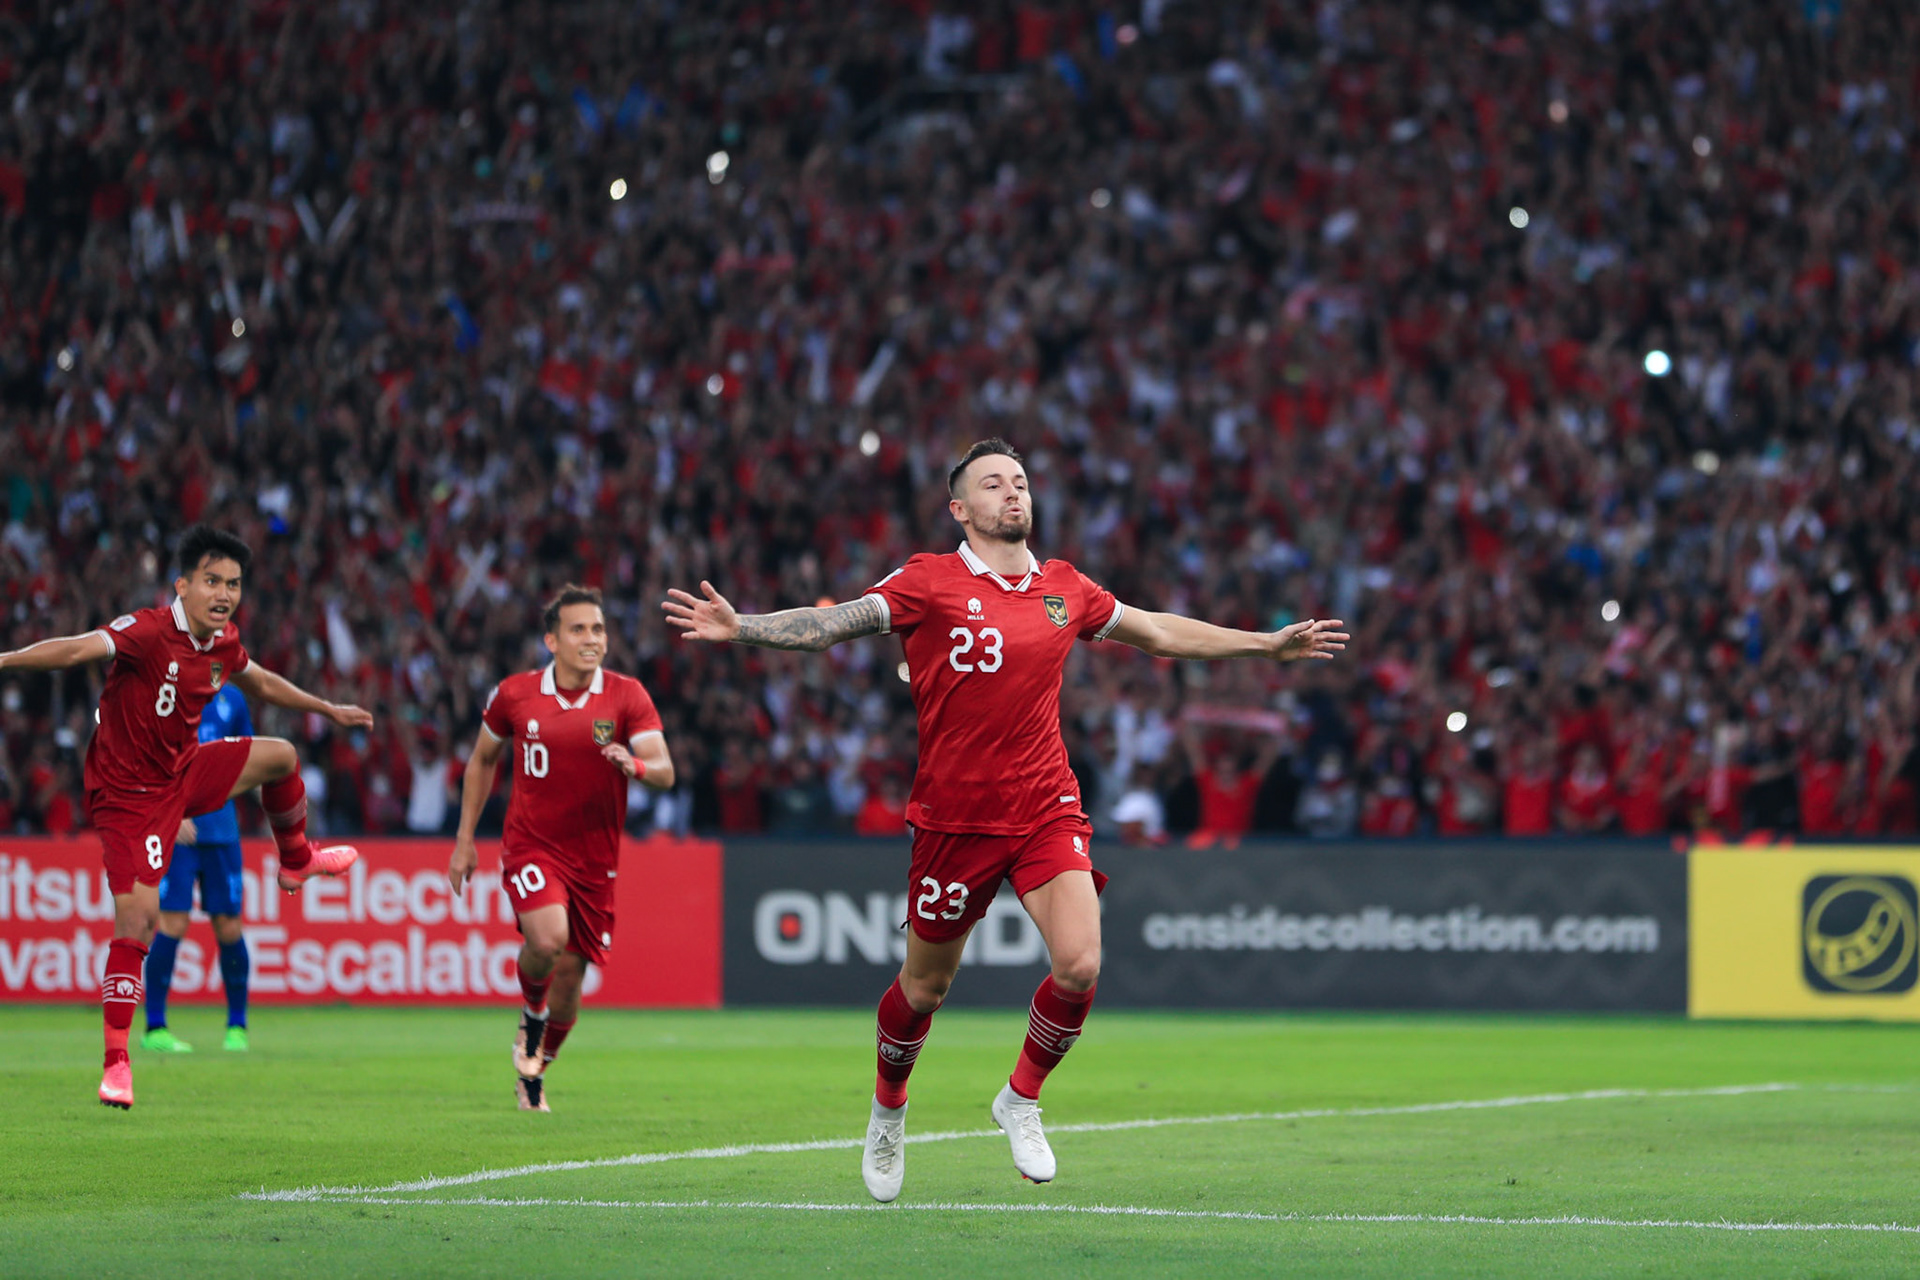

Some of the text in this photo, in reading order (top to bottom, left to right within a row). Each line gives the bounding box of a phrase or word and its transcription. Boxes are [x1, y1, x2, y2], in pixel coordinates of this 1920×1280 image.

[948, 627, 1004, 673] 23
[154, 683, 177, 717] 8
[522, 742, 549, 778] 10
[145, 835, 163, 871] 8
[510, 863, 546, 900] 10
[916, 876, 970, 921] 23
[1142, 903, 1658, 951] onsidecollection.com
